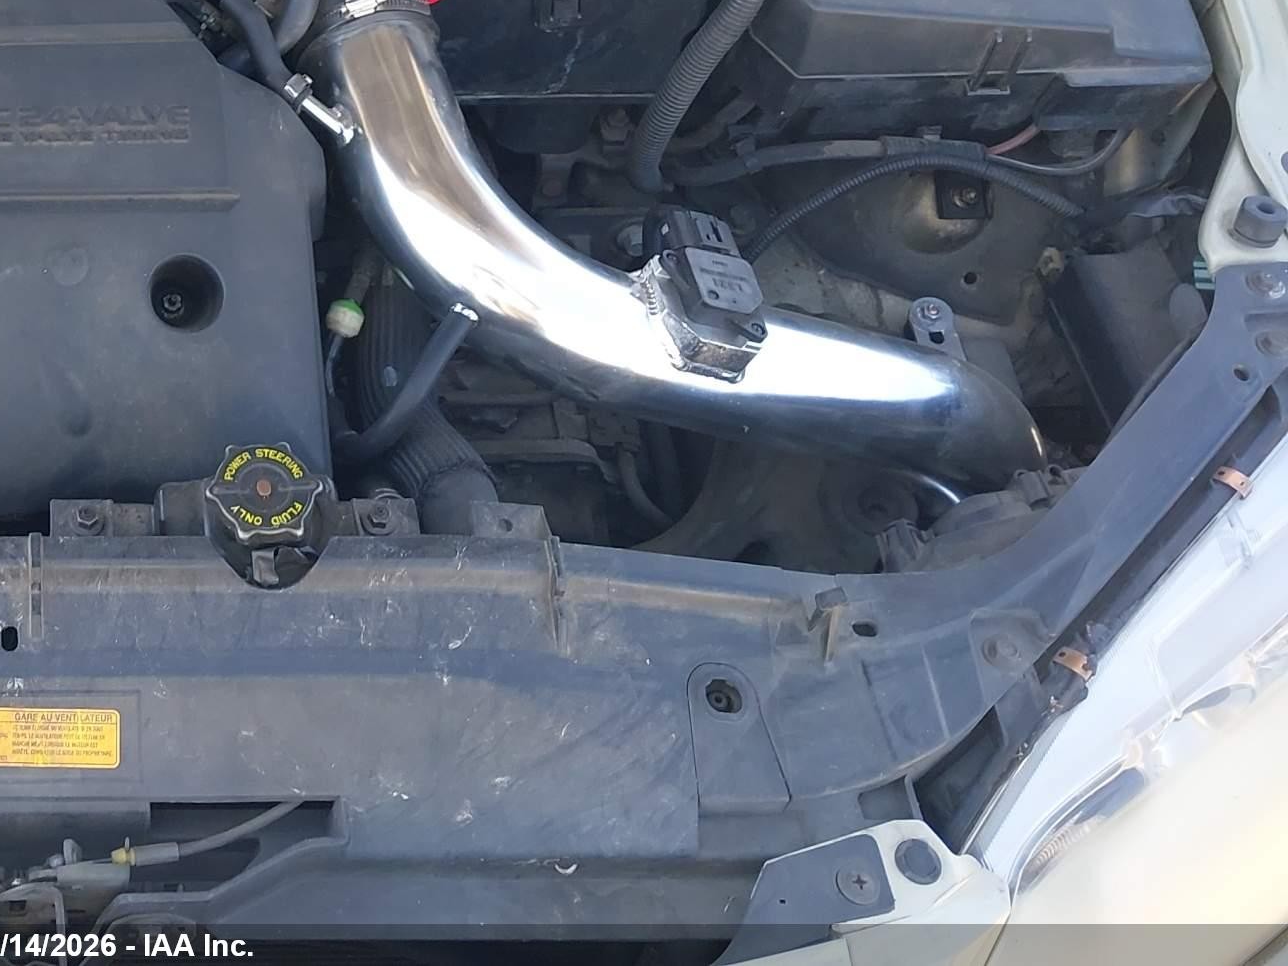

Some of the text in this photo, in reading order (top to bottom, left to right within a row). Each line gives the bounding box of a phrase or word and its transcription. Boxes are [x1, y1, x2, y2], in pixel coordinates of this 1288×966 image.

[224, 448, 304, 481] POWER STEERING
[230, 501, 303, 526] FLUID ONLY
[14, 713, 39, 721] GARE
